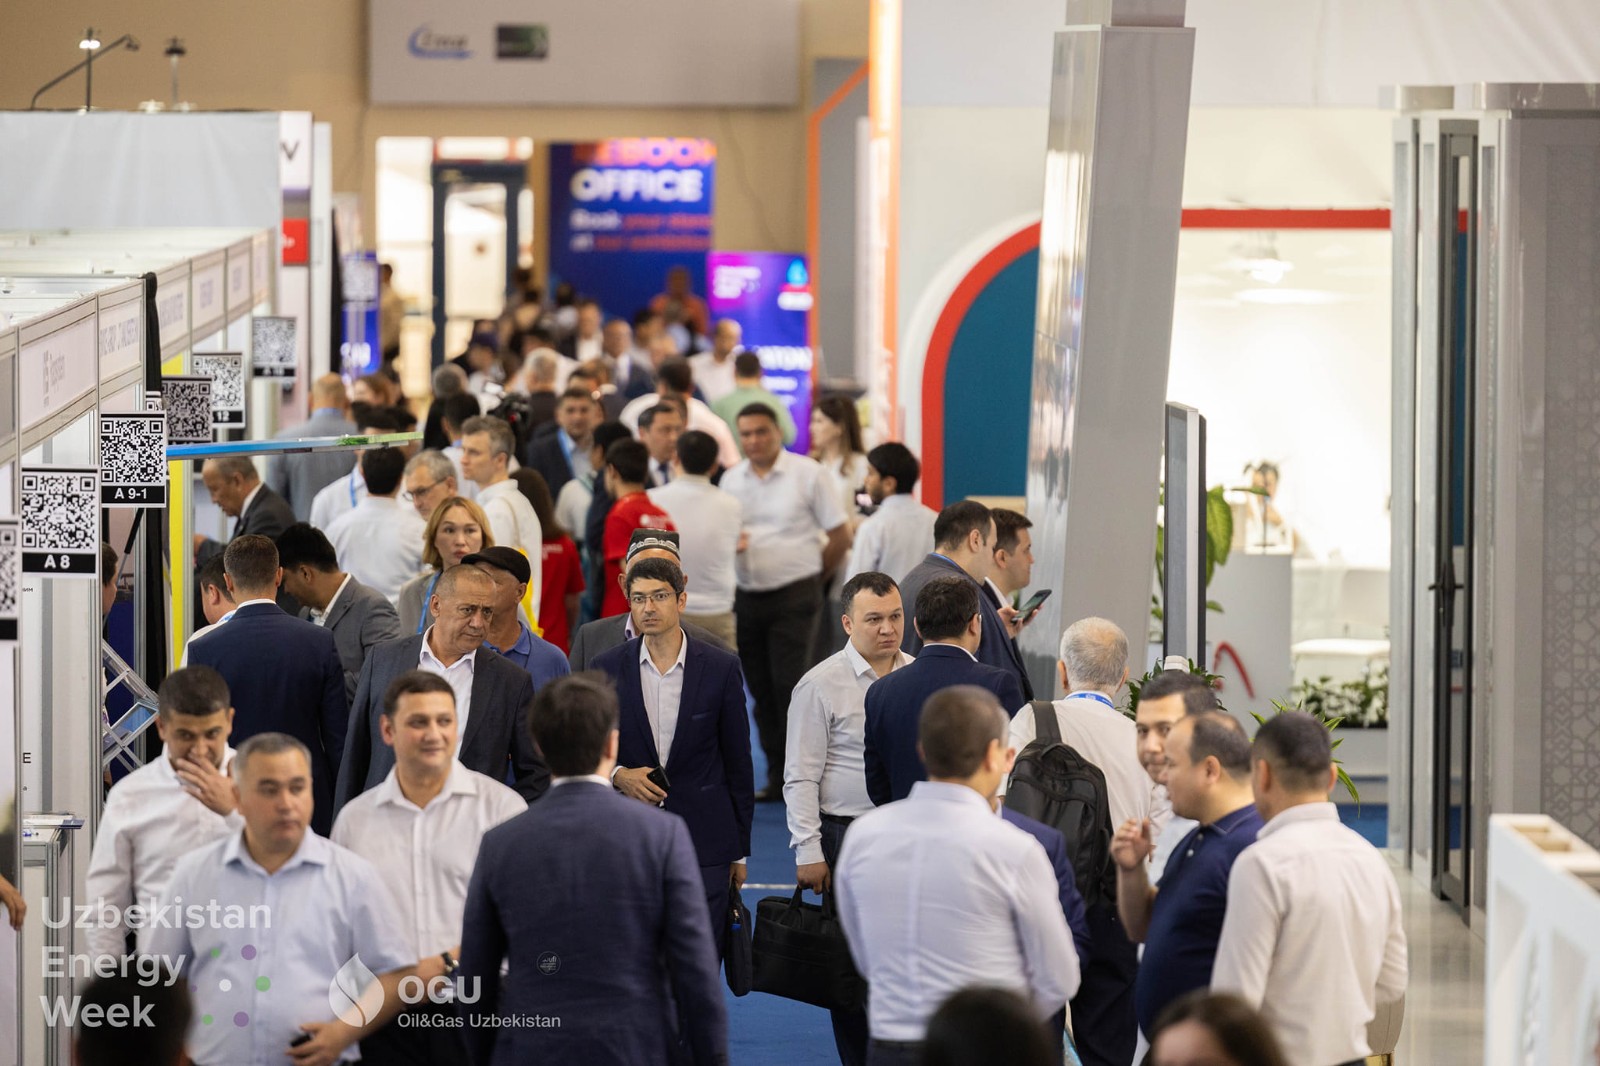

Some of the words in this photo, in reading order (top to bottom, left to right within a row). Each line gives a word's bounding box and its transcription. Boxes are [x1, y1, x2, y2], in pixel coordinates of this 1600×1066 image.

[570, 168, 704, 202] OFFICE
[217, 411, 229, 421] 12
[114, 488, 125, 499] A
[128, 487, 147, 499] 9-1
[44, 555, 57, 569] A
[60, 555, 71, 569] 8
